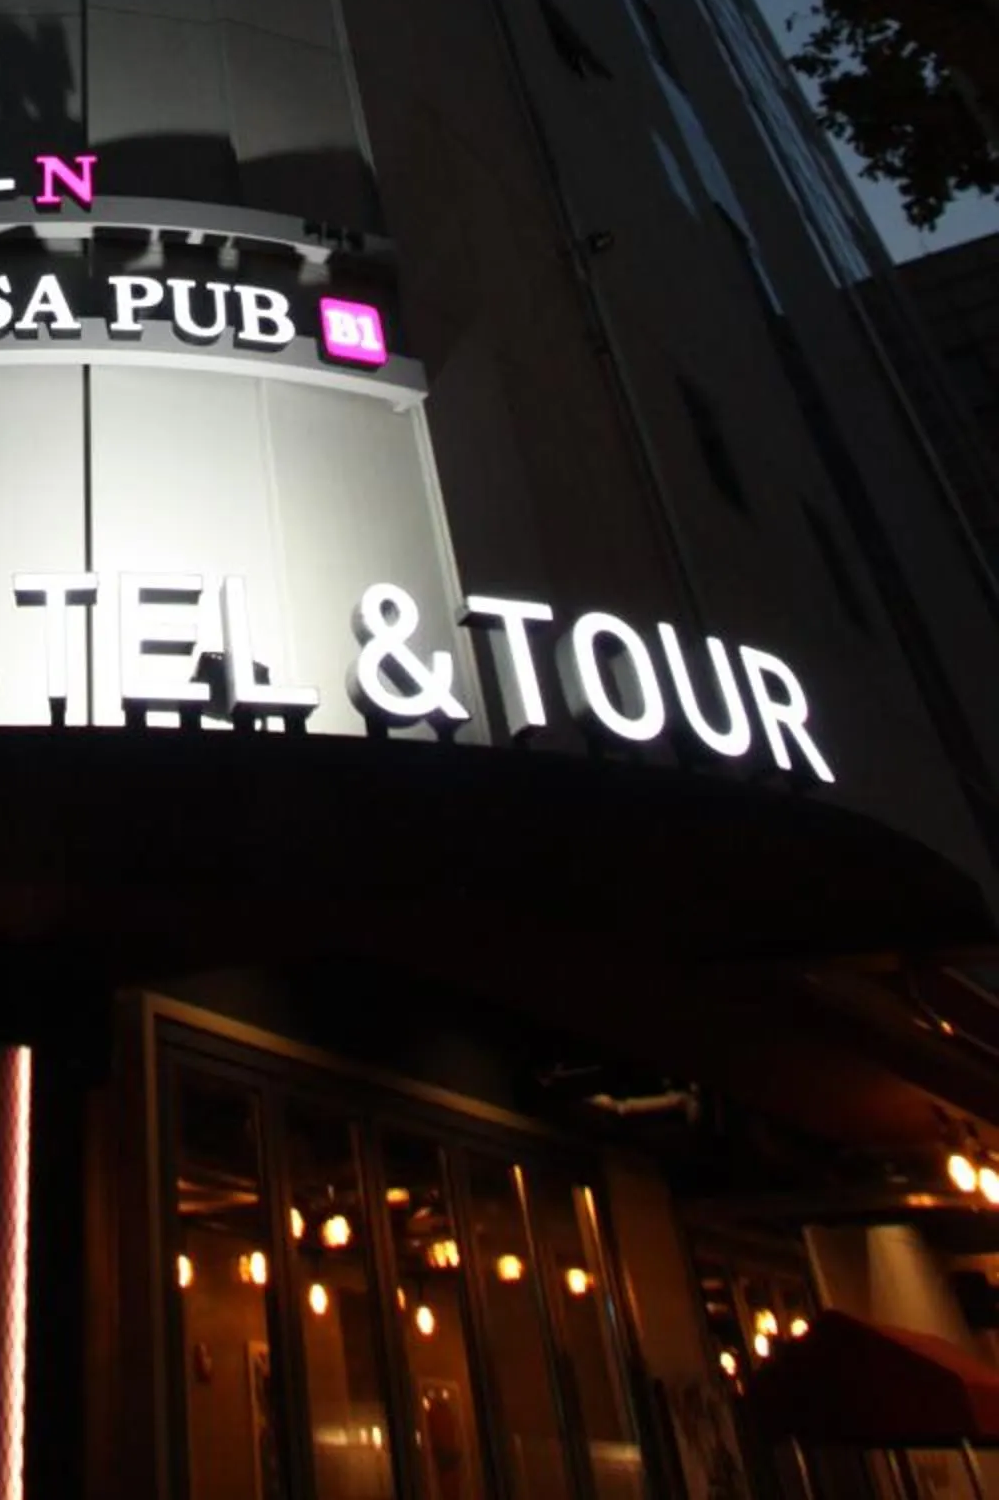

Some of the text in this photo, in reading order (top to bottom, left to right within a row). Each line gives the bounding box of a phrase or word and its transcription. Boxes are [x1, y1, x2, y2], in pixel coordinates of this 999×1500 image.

[35, 155, 98, 205] N
[108, 275, 296, 347] PUB
[324, 308, 382, 352] B1
[356, 581, 470, 719] &
[466, 595, 837, 784] TOUR
